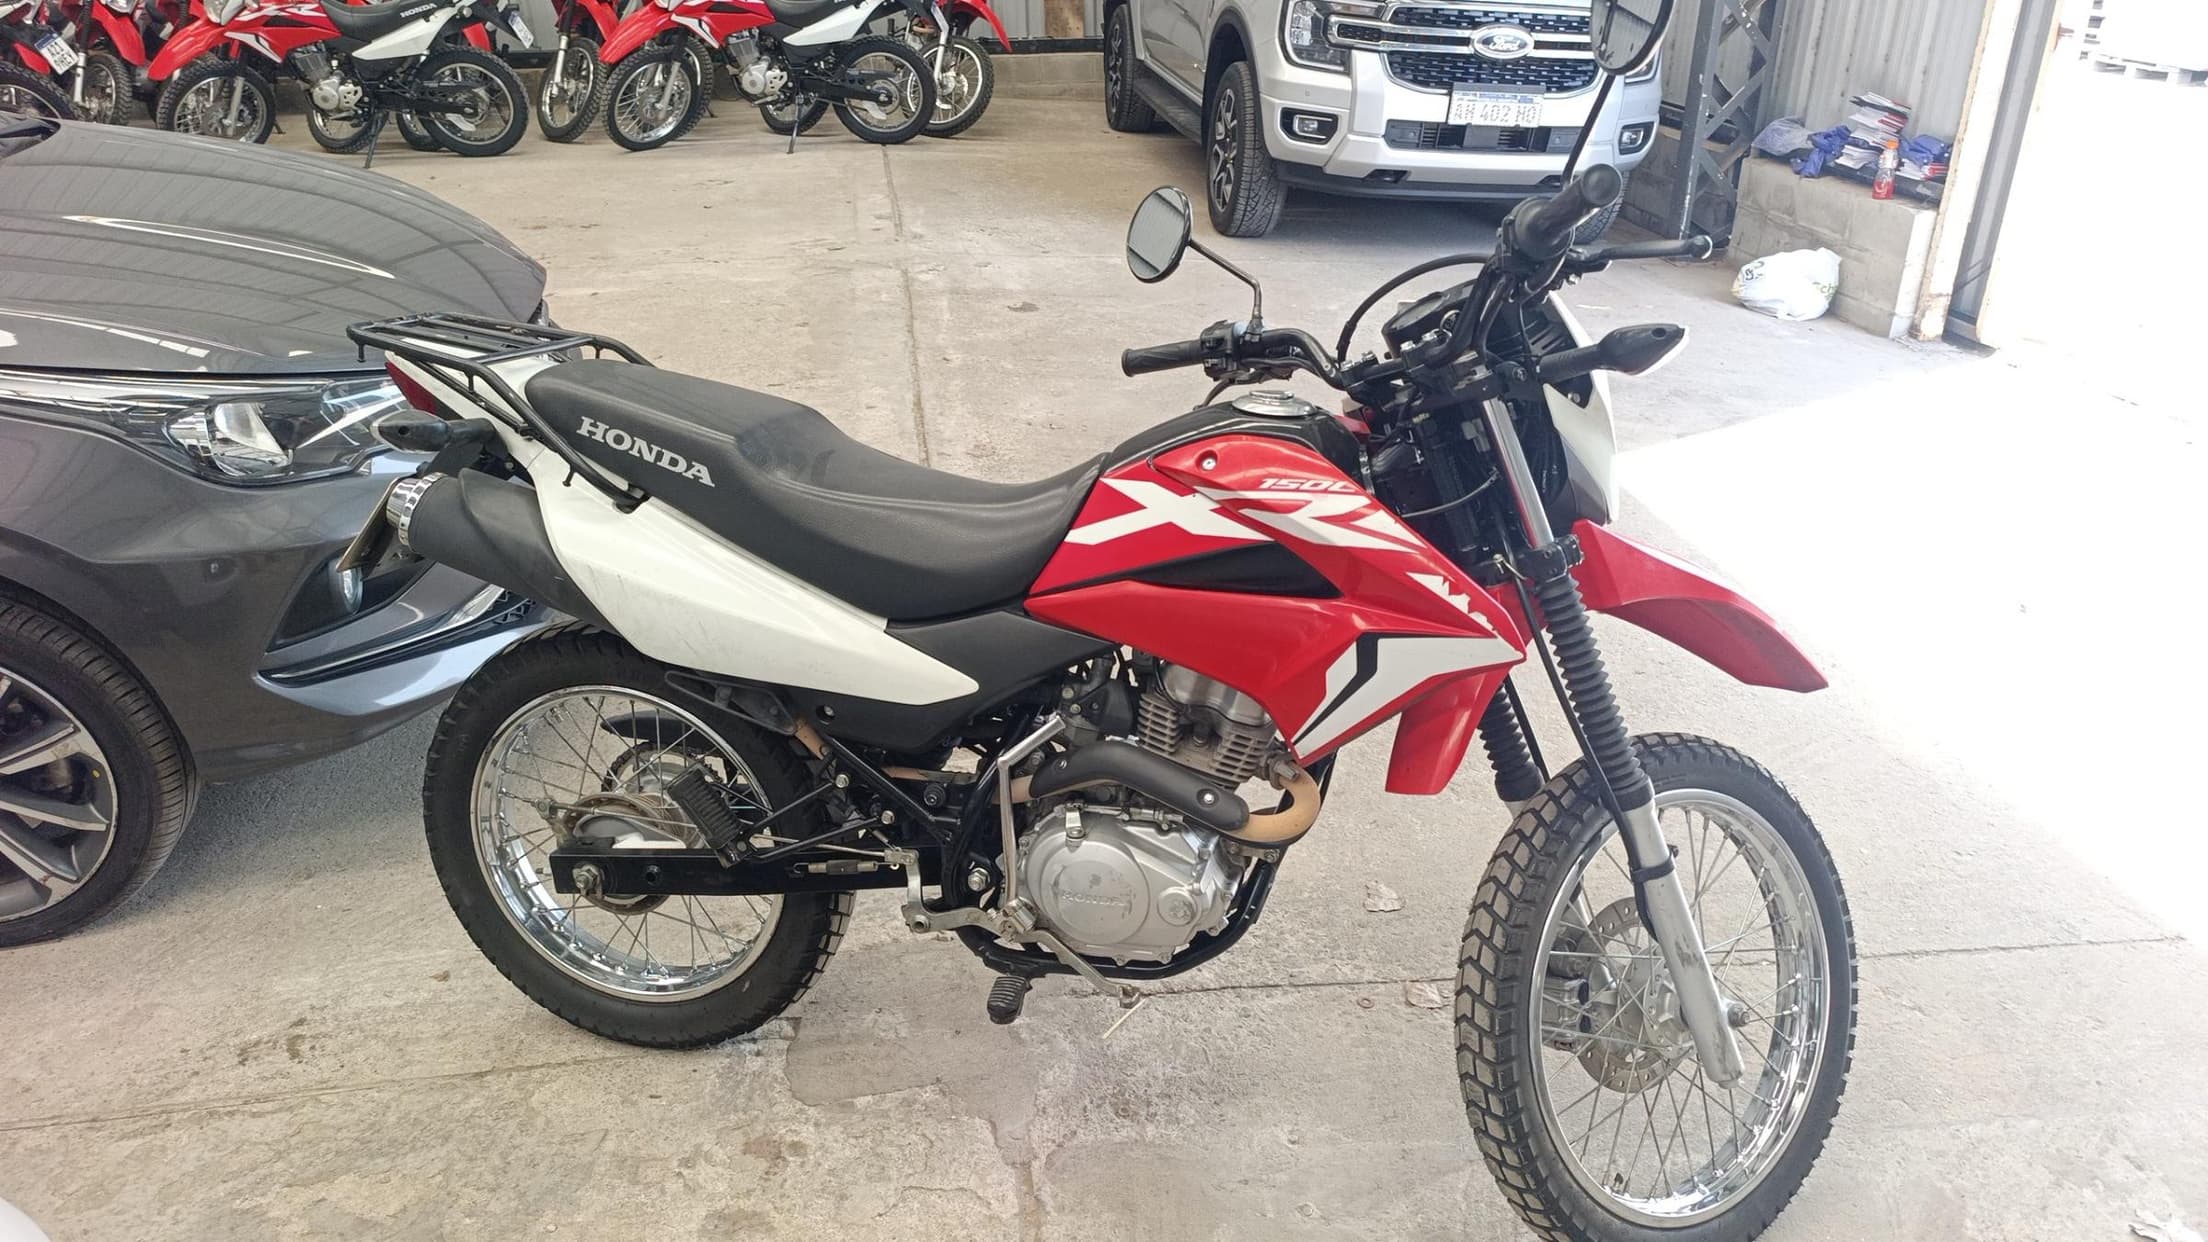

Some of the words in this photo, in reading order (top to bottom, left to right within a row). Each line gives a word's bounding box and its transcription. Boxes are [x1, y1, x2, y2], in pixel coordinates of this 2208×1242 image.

[400, 2, 438, 18] HONDA
[1488, 34, 1521, 51] Ford
[575, 416, 716, 488] HONDA
[1064, 477, 1429, 553] XR
